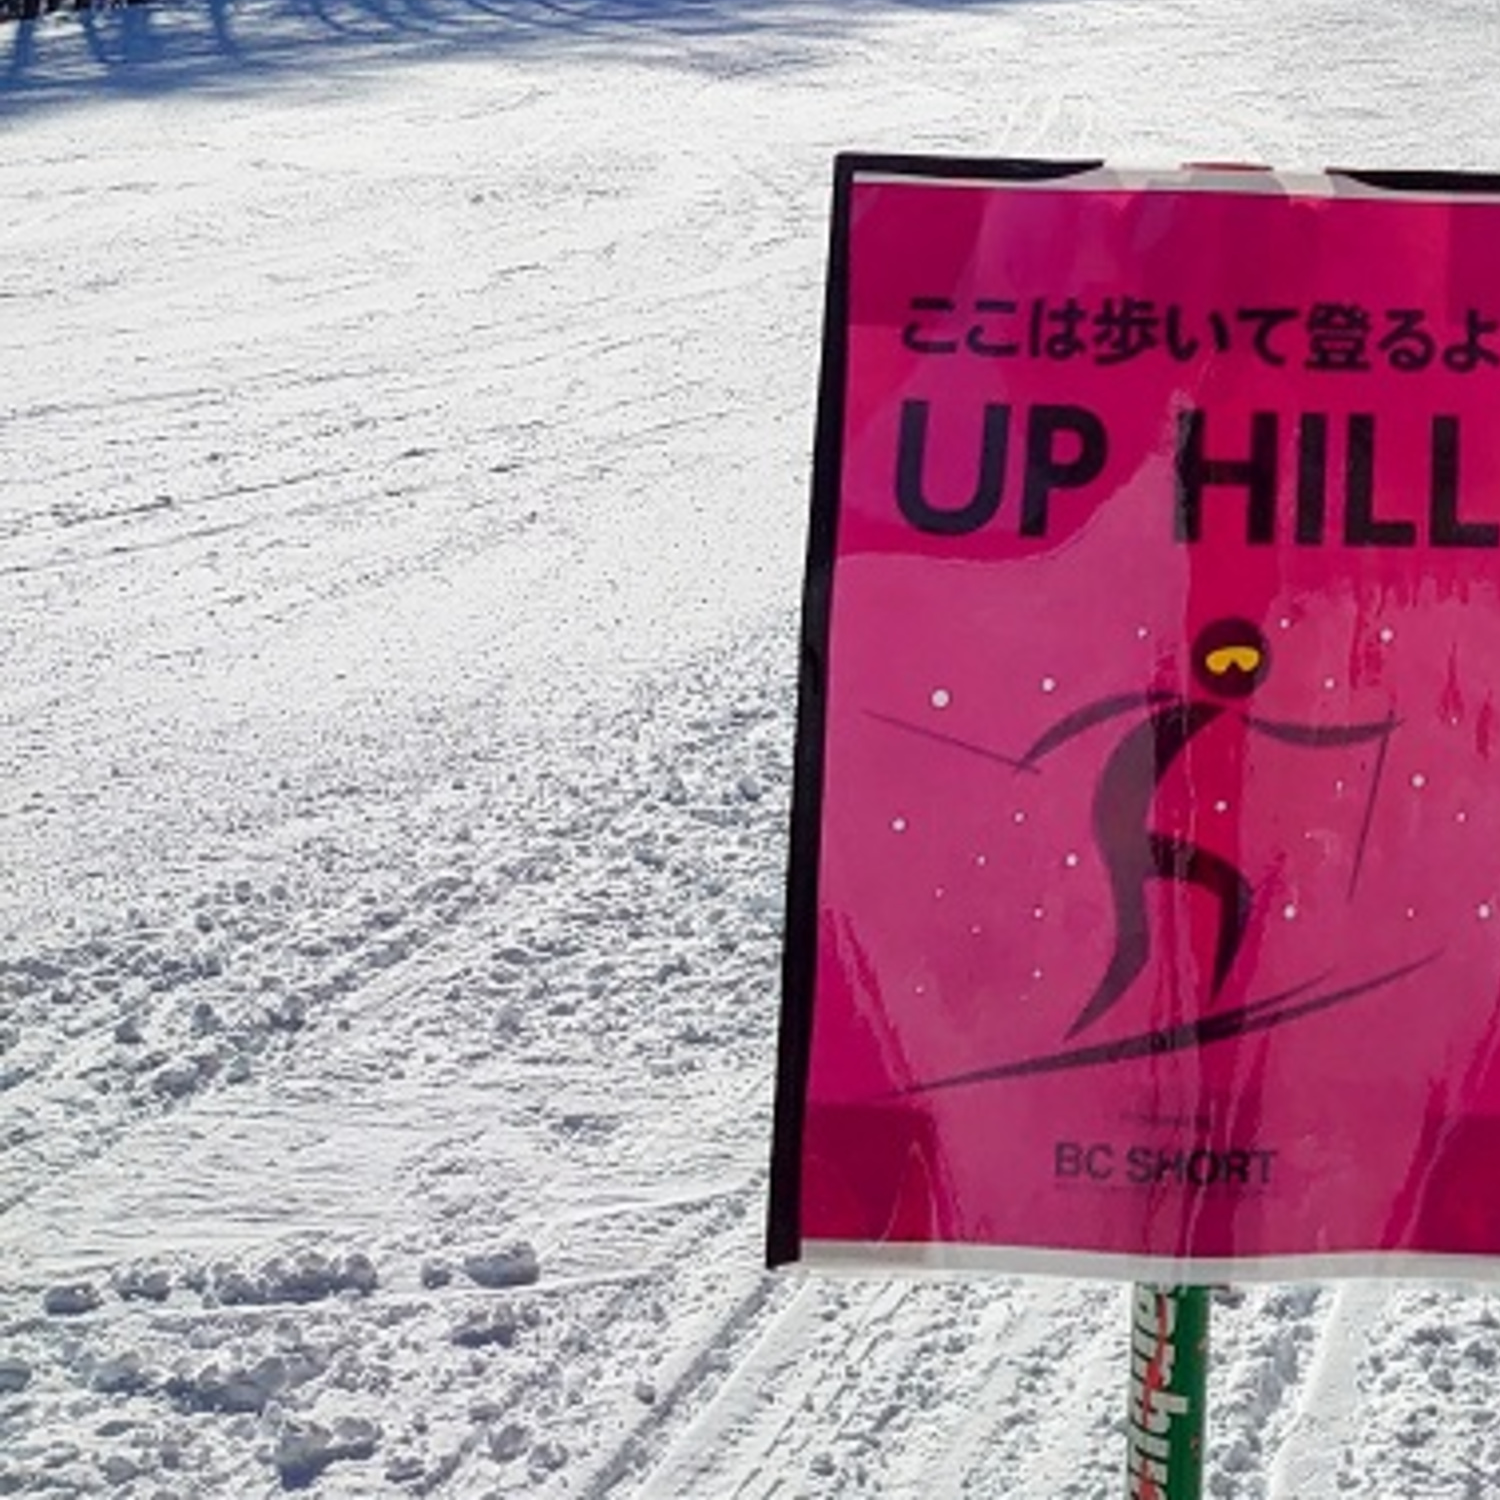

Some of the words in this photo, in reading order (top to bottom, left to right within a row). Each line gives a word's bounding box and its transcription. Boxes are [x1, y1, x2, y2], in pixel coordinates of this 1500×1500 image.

[894, 398, 1109, 538] UP
[1054, 1141, 1112, 1180] BC
[1126, 1146, 1277, 1186] SHORT
